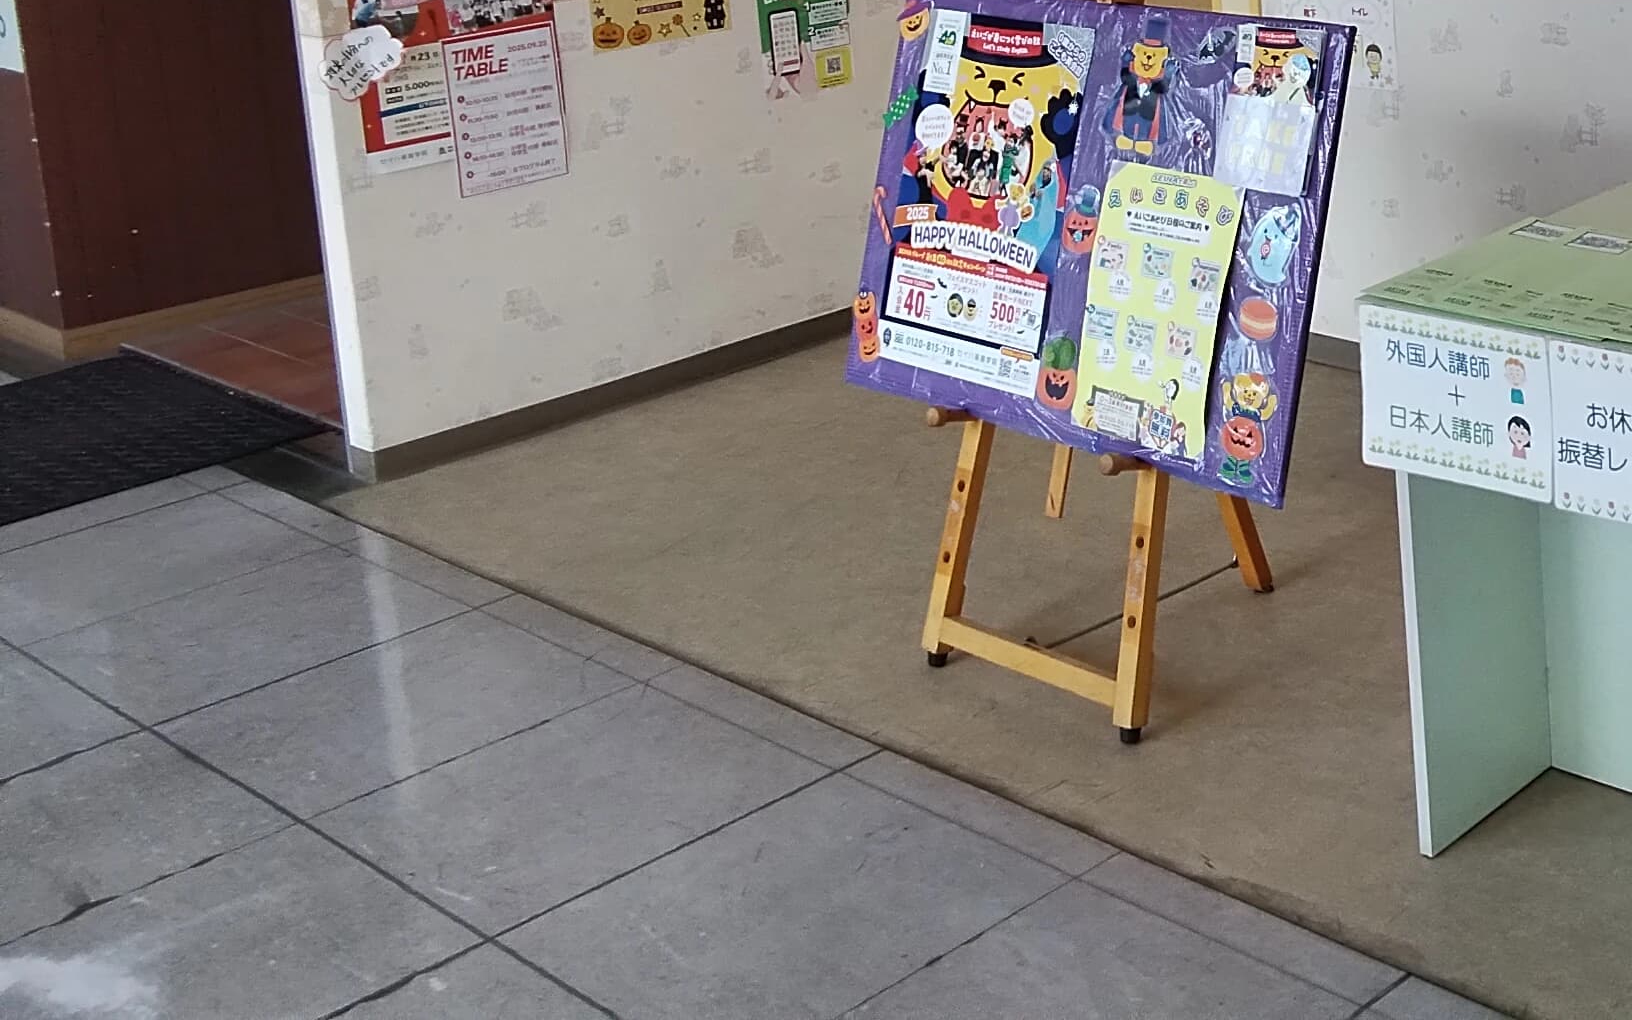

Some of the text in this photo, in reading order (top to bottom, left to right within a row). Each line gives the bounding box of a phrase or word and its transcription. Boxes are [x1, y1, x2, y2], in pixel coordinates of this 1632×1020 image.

[451, 44, 495, 66] TIME
[454, 58, 509, 82] TABLE
[906, 206, 929, 221] 2025
[914, 225, 1034, 269] HAPPY HALLOWEEN
[903, 288, 926, 319] 40
[989, 301, 1015, 324] 500
[905, 335, 955, 357] 0120-815-718
[1386, 338, 1491, 381] 外国人講師
[1389, 404, 1495, 449] 日本人講師
